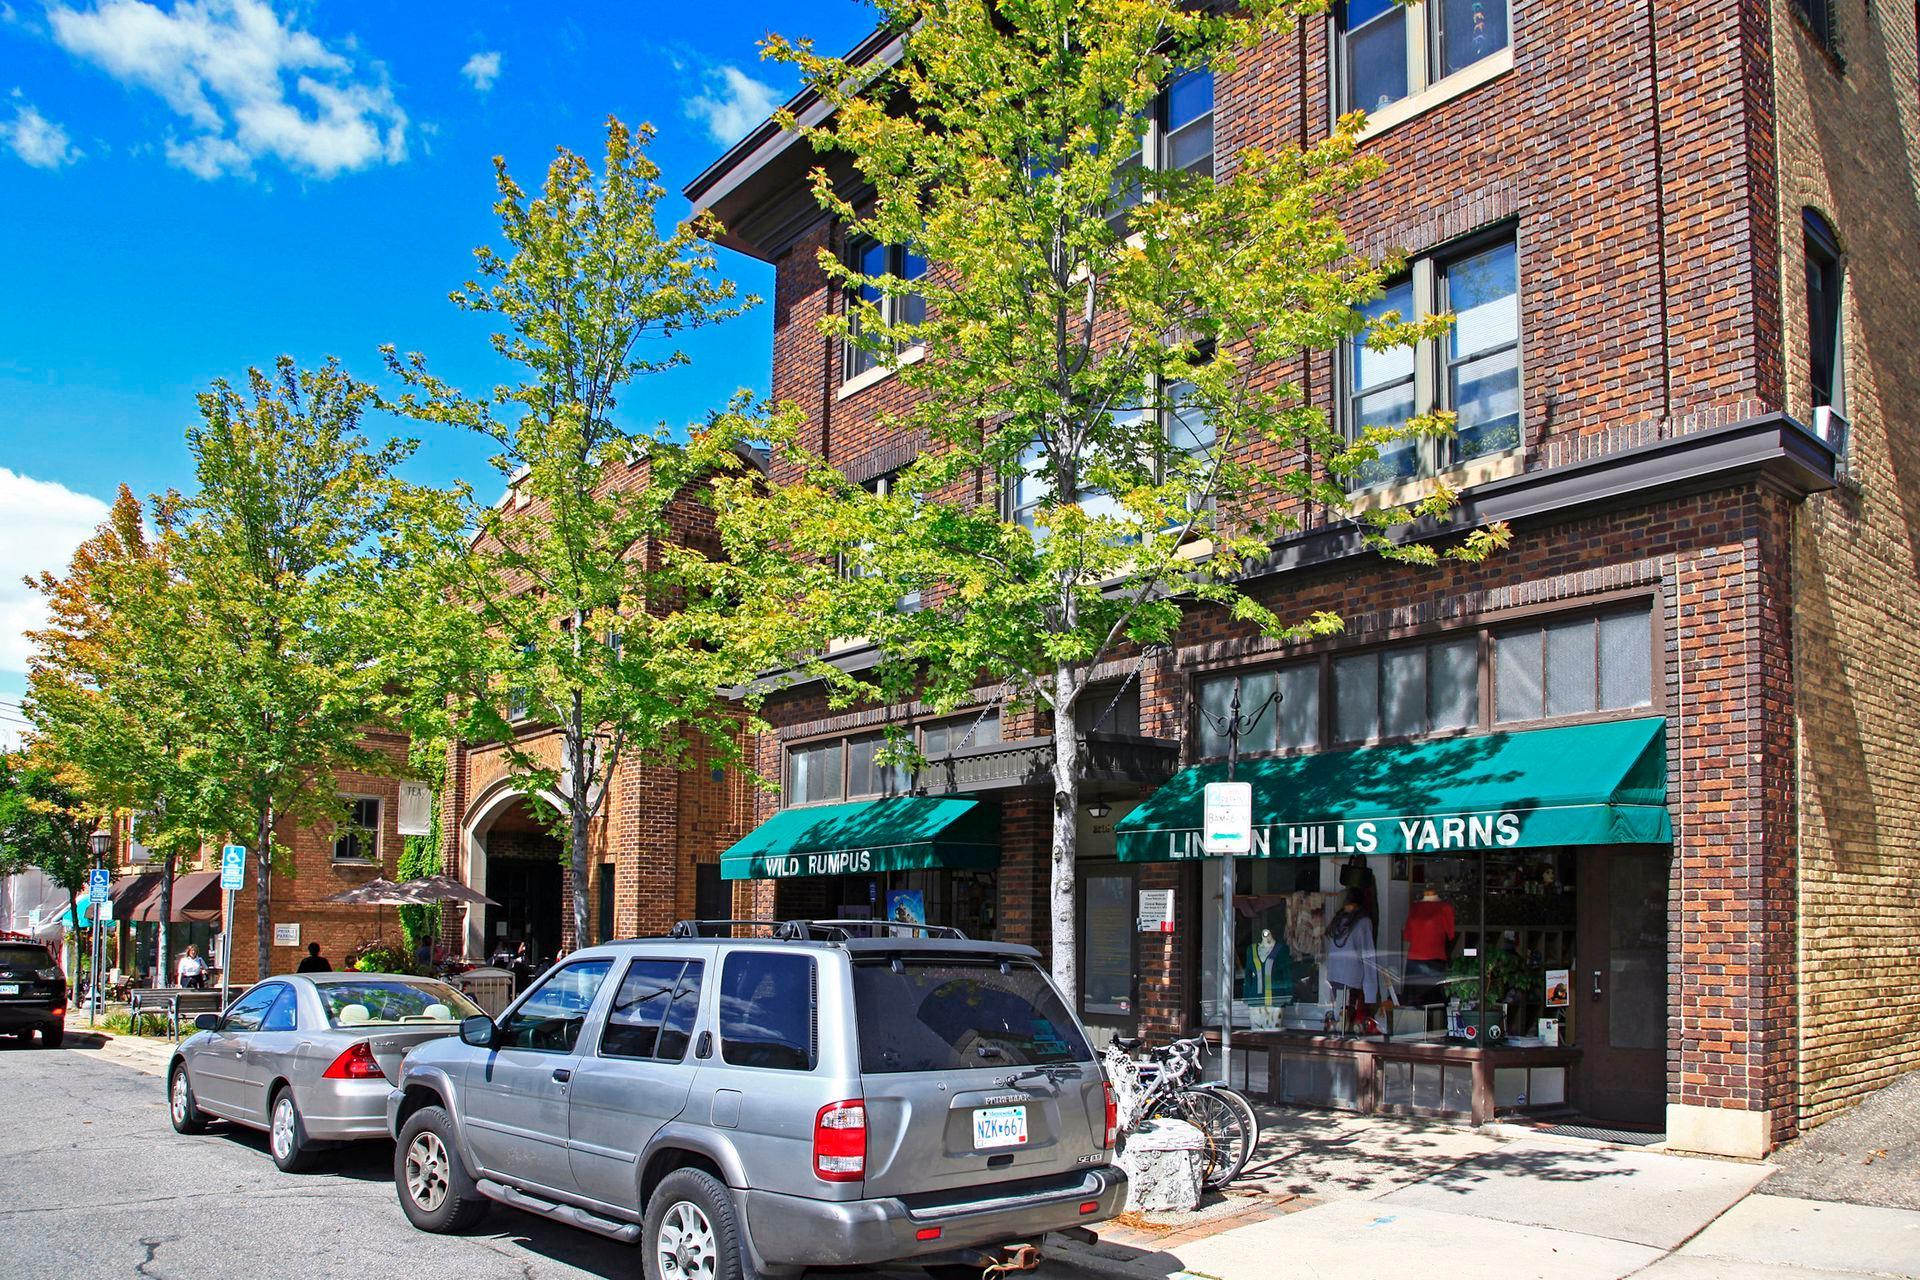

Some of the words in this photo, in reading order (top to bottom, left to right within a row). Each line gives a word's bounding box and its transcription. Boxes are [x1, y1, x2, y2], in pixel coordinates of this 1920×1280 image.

[407, 786, 421, 797] TEA
[1169, 828, 1270, 858] LINN
[1289, 822, 1378, 855] HILLS
[1399, 813, 1520, 851] YARNS
[765, 857, 799, 877] WILD
[808, 850, 871, 874] RUMPUS
